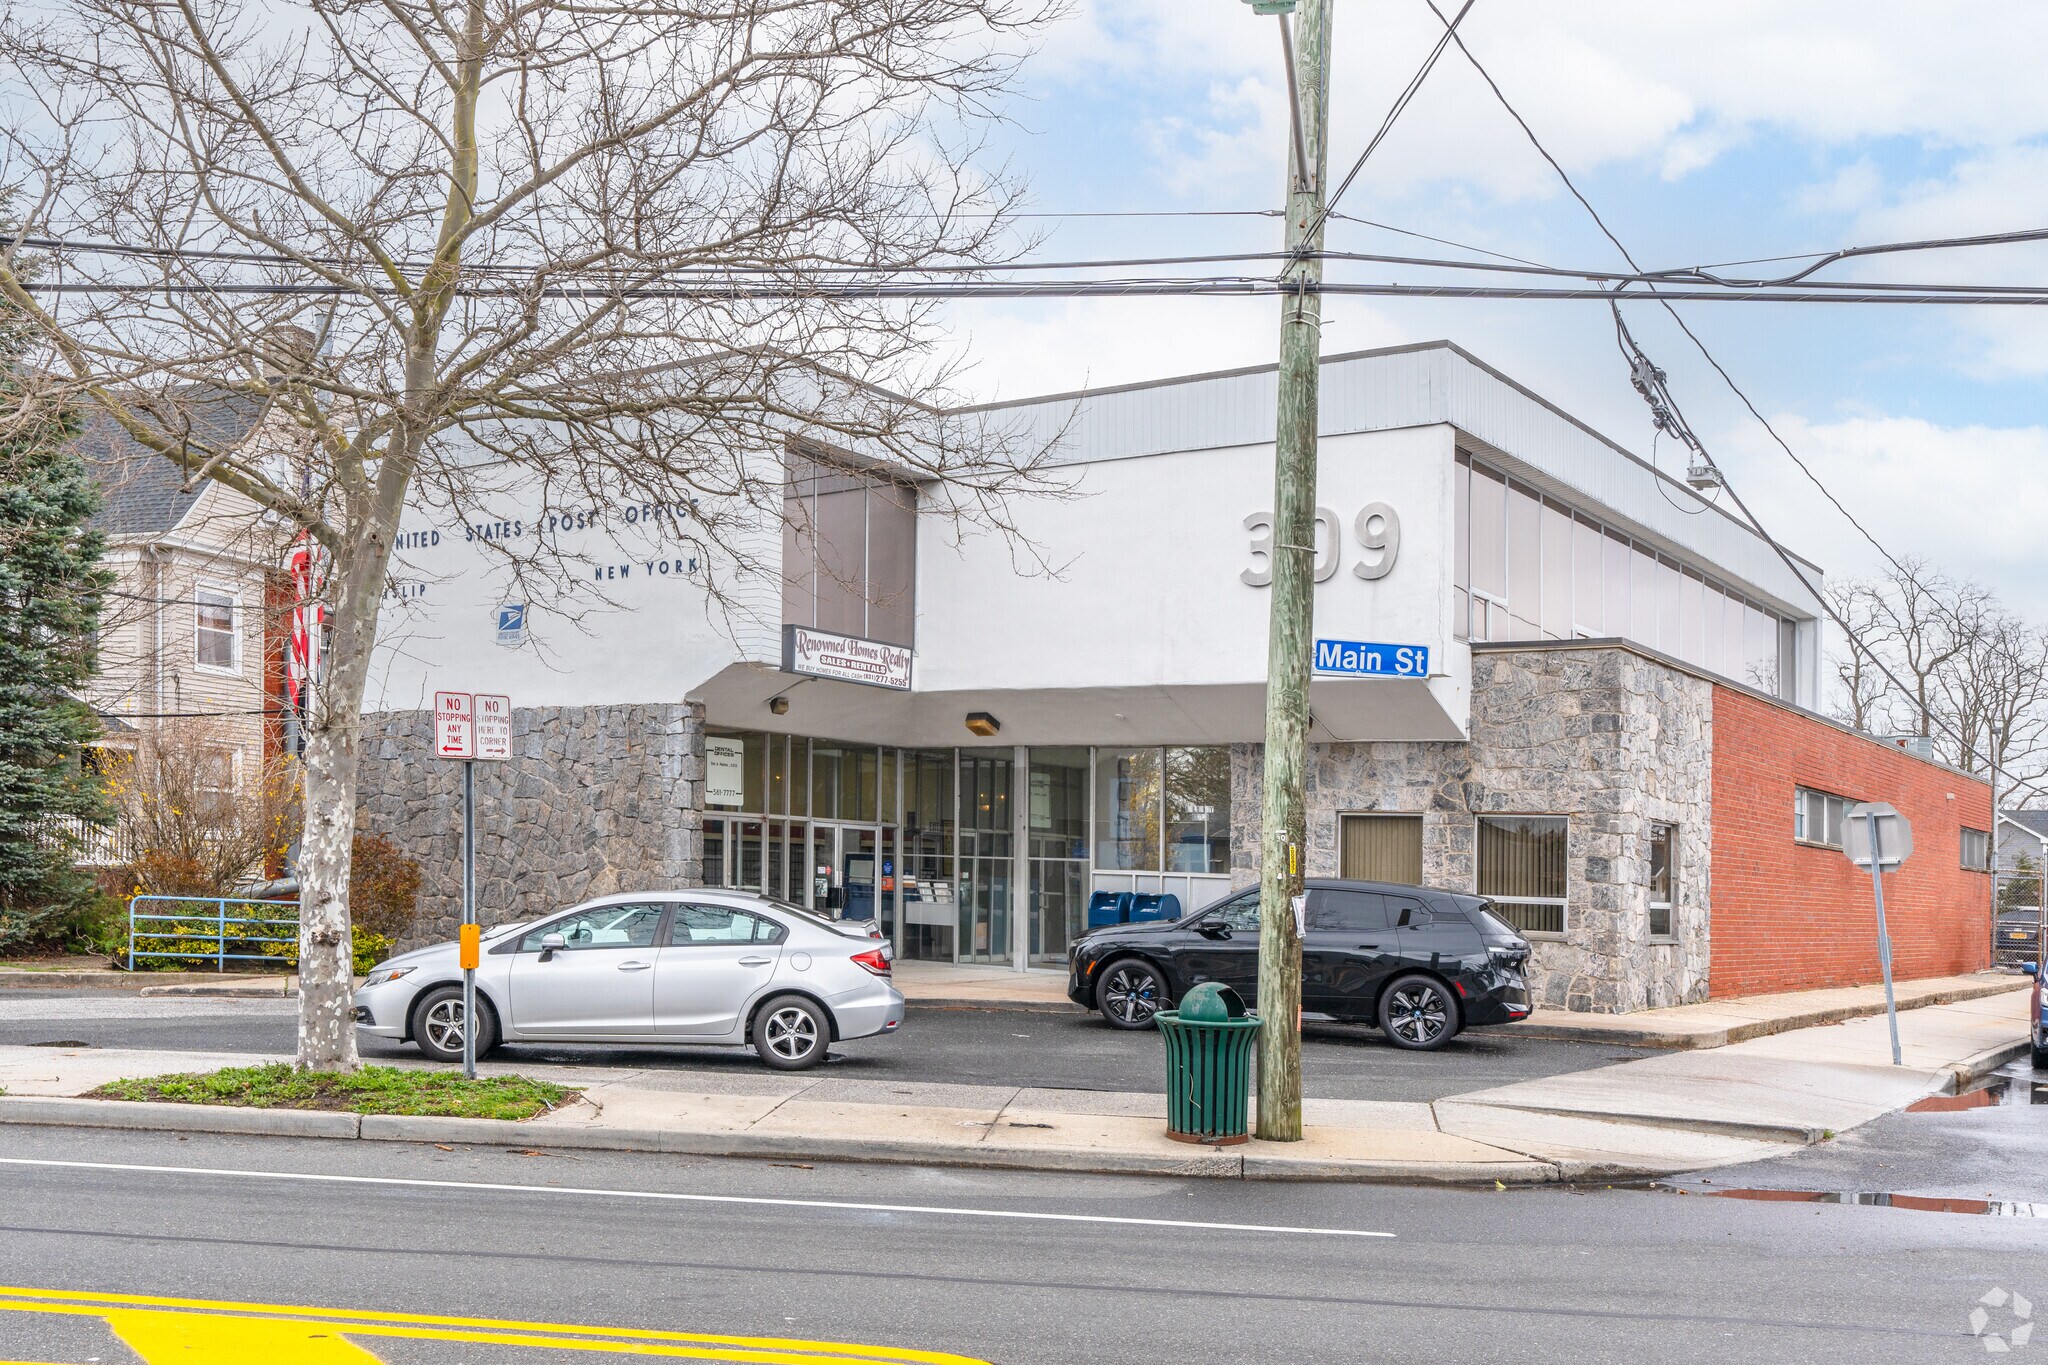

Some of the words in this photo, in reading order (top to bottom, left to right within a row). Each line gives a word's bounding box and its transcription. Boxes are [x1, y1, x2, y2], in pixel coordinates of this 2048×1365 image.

[395, 530, 440, 550] NITED
[466, 520, 521, 542] STATES
[549, 511, 594, 533] POST
[1240, 501, 1401, 587] 309
[595, 564, 630, 581] NEW
[646, 557, 699, 576] YORK
[796, 631, 847, 661] Renowned
[847, 640, 879, 660] Homes
[880, 646, 910, 681] Realty
[1318, 643, 1382, 671] Main
[1394, 647, 1425, 674] St
[815, 666, 832, 675] HOMES
[446, 698, 461, 711] NO
[485, 700, 499, 713] NO
[437, 712, 471, 723] STOPPING
[476, 715, 509, 725] STOPPING
[447, 724, 462, 733] ANY
[478, 726, 494, 735] HERE
[500, 727, 508, 736] TO
[446, 735, 463, 745] TIME
[480, 736, 507, 746] CORNER
